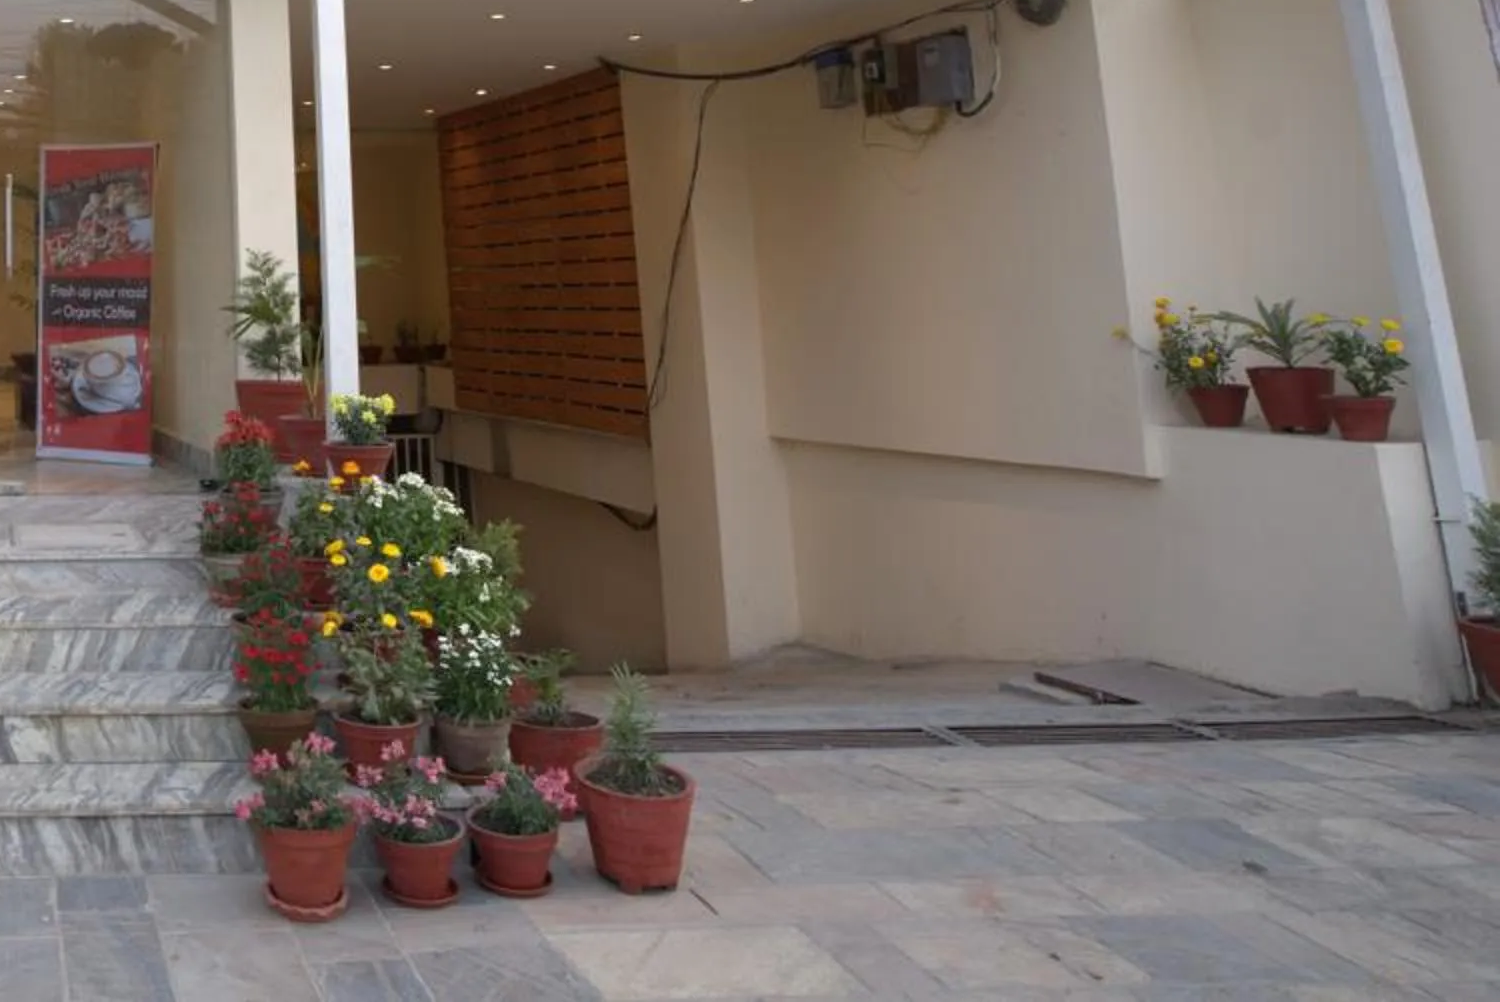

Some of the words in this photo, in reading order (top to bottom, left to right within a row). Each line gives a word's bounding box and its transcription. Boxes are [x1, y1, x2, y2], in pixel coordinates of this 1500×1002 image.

[93, 287, 116, 302] your
[63, 304, 102, 320] Organic
[103, 304, 137, 320] Coffee
